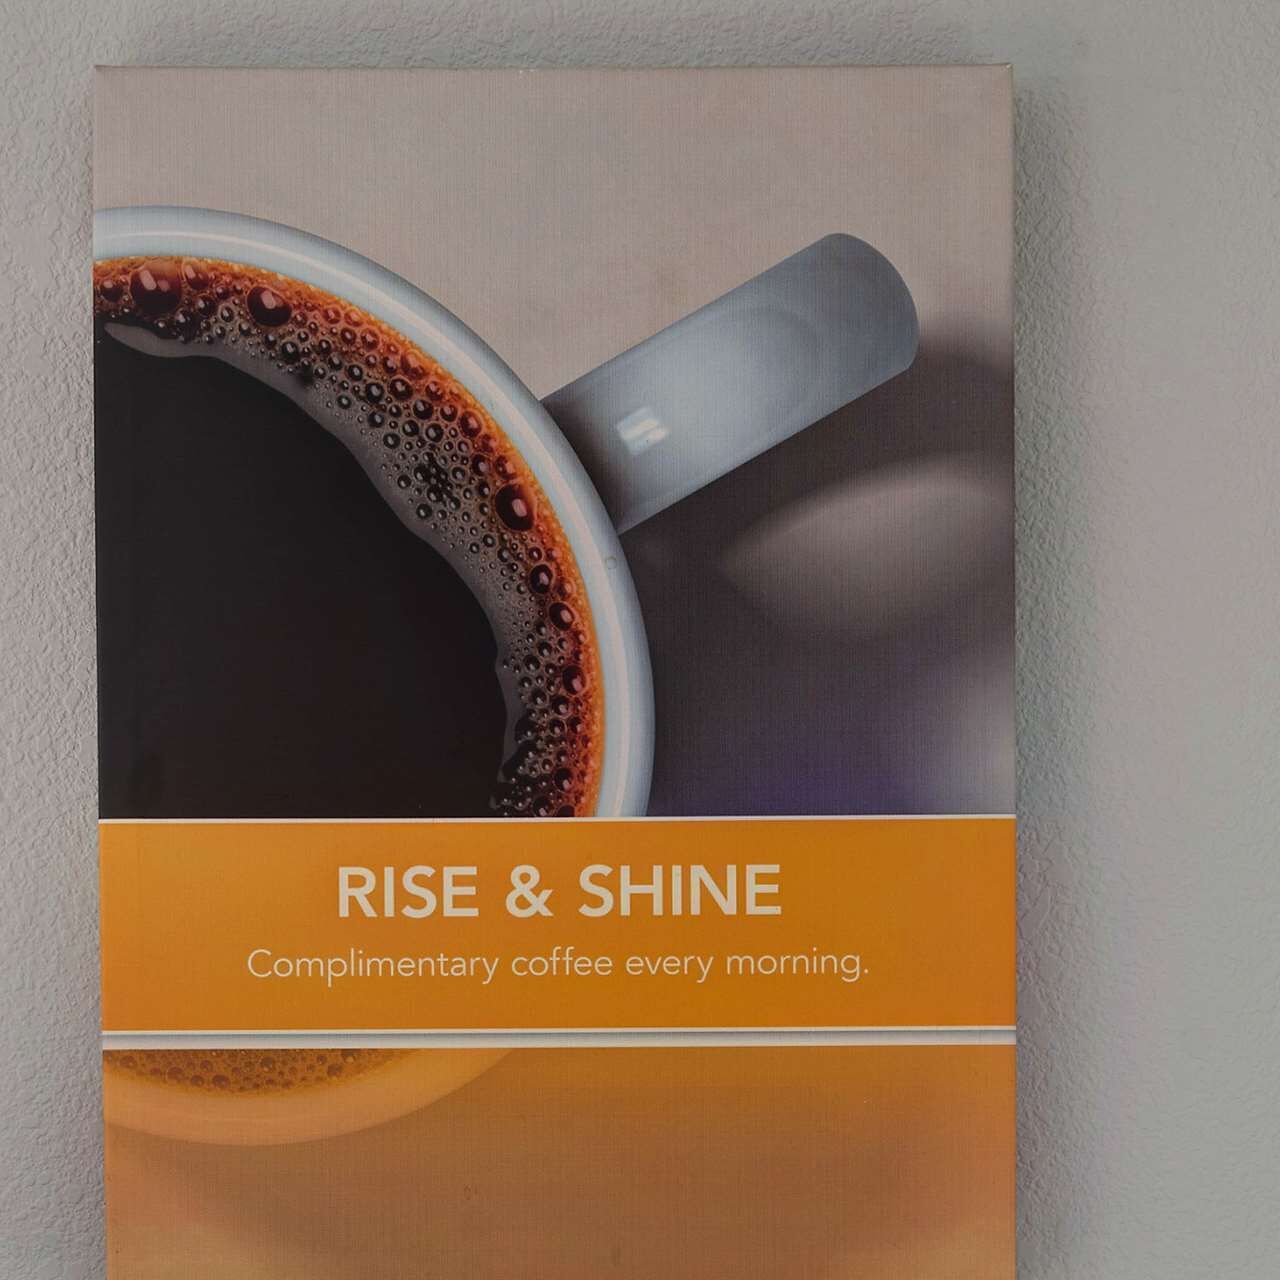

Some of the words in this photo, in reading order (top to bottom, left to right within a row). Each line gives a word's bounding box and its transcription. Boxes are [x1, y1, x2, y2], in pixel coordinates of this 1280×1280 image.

[338, 865, 479, 918] RISE
[505, 864, 554, 918] &
[578, 864, 781, 917] SHINE
[247, 947, 500, 987] Complimentary
[511, 946, 613, 977] coffee
[626, 955, 714, 983] every
[726, 947, 870, 983] morning.
